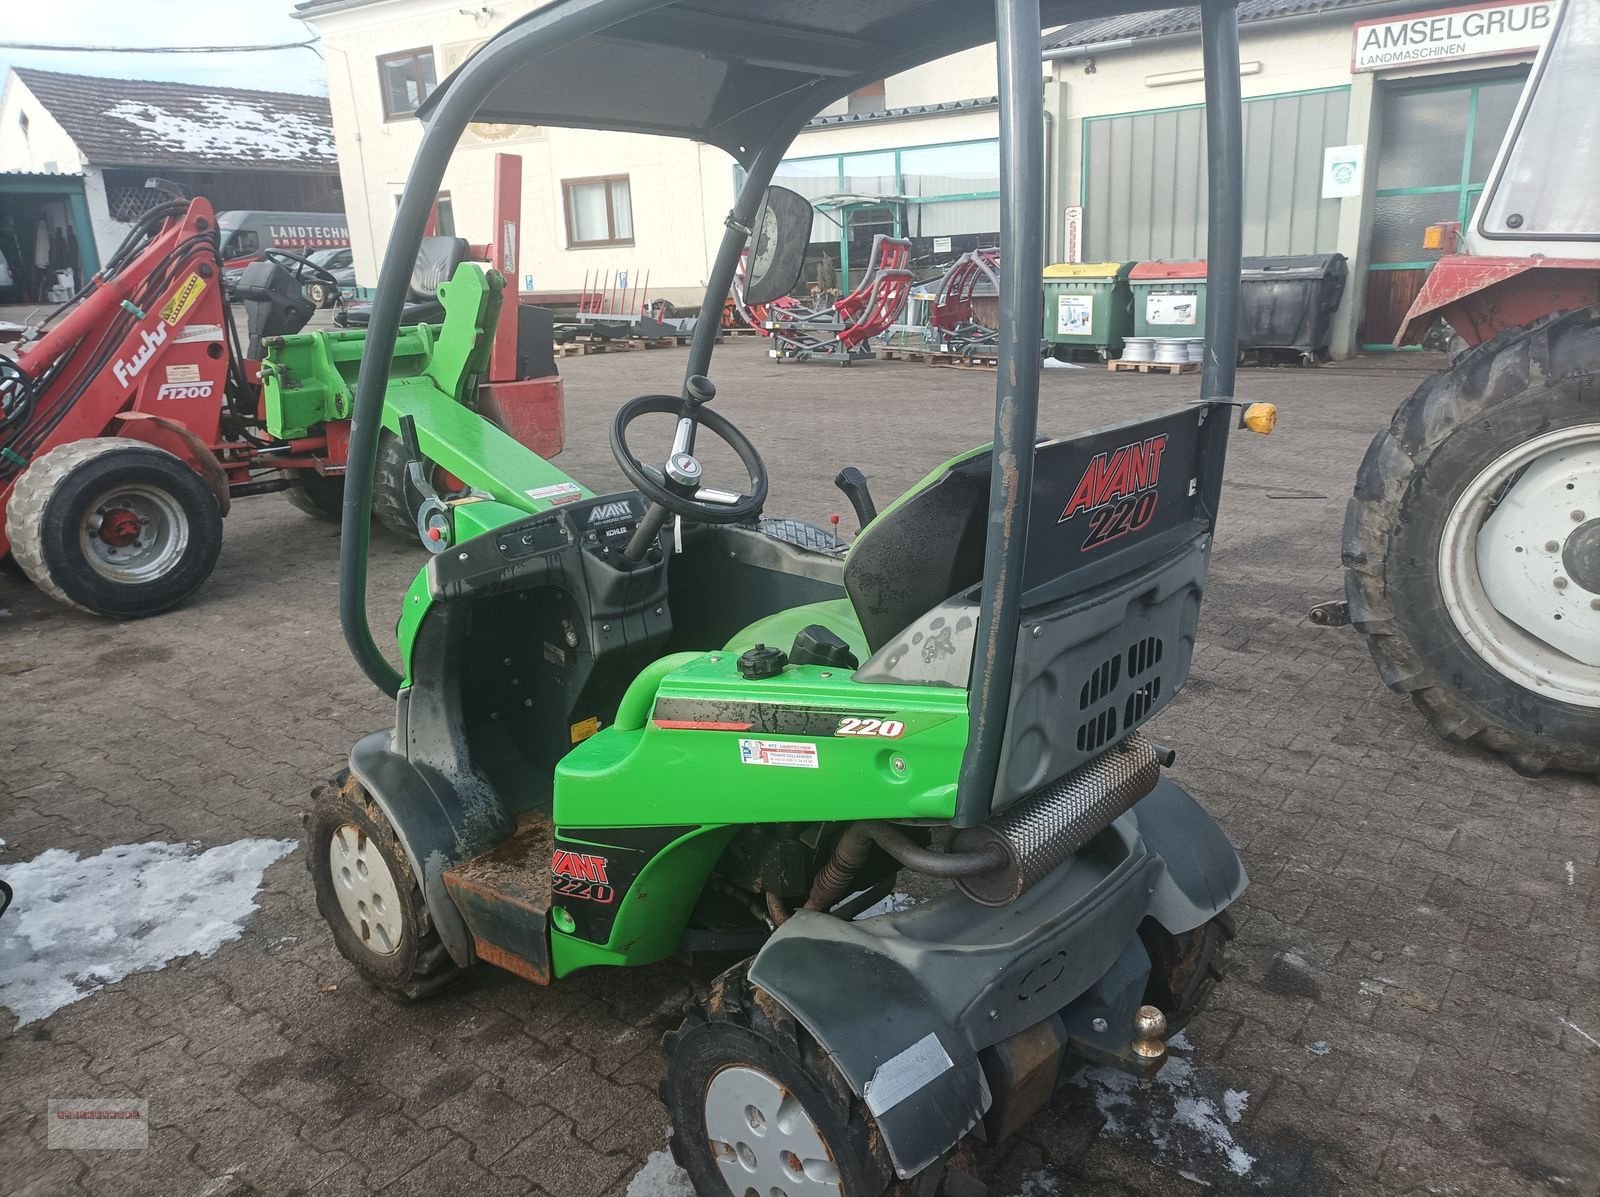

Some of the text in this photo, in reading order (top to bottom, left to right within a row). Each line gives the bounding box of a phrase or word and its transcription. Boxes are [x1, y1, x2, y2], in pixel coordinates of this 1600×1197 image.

[1361, 43, 1466, 66] LANDMASCHINEN
[270, 226, 349, 238] LANDTECHN
[157, 381, 214, 400] F1200
[1057, 433, 1168, 524] AVANT
[587, 501, 632, 523] AVANT
[1081, 490, 1158, 552] 220
[605, 526, 628, 537] KOHLER
[835, 717, 906, 739] 220
[552, 874, 614, 905] 220
